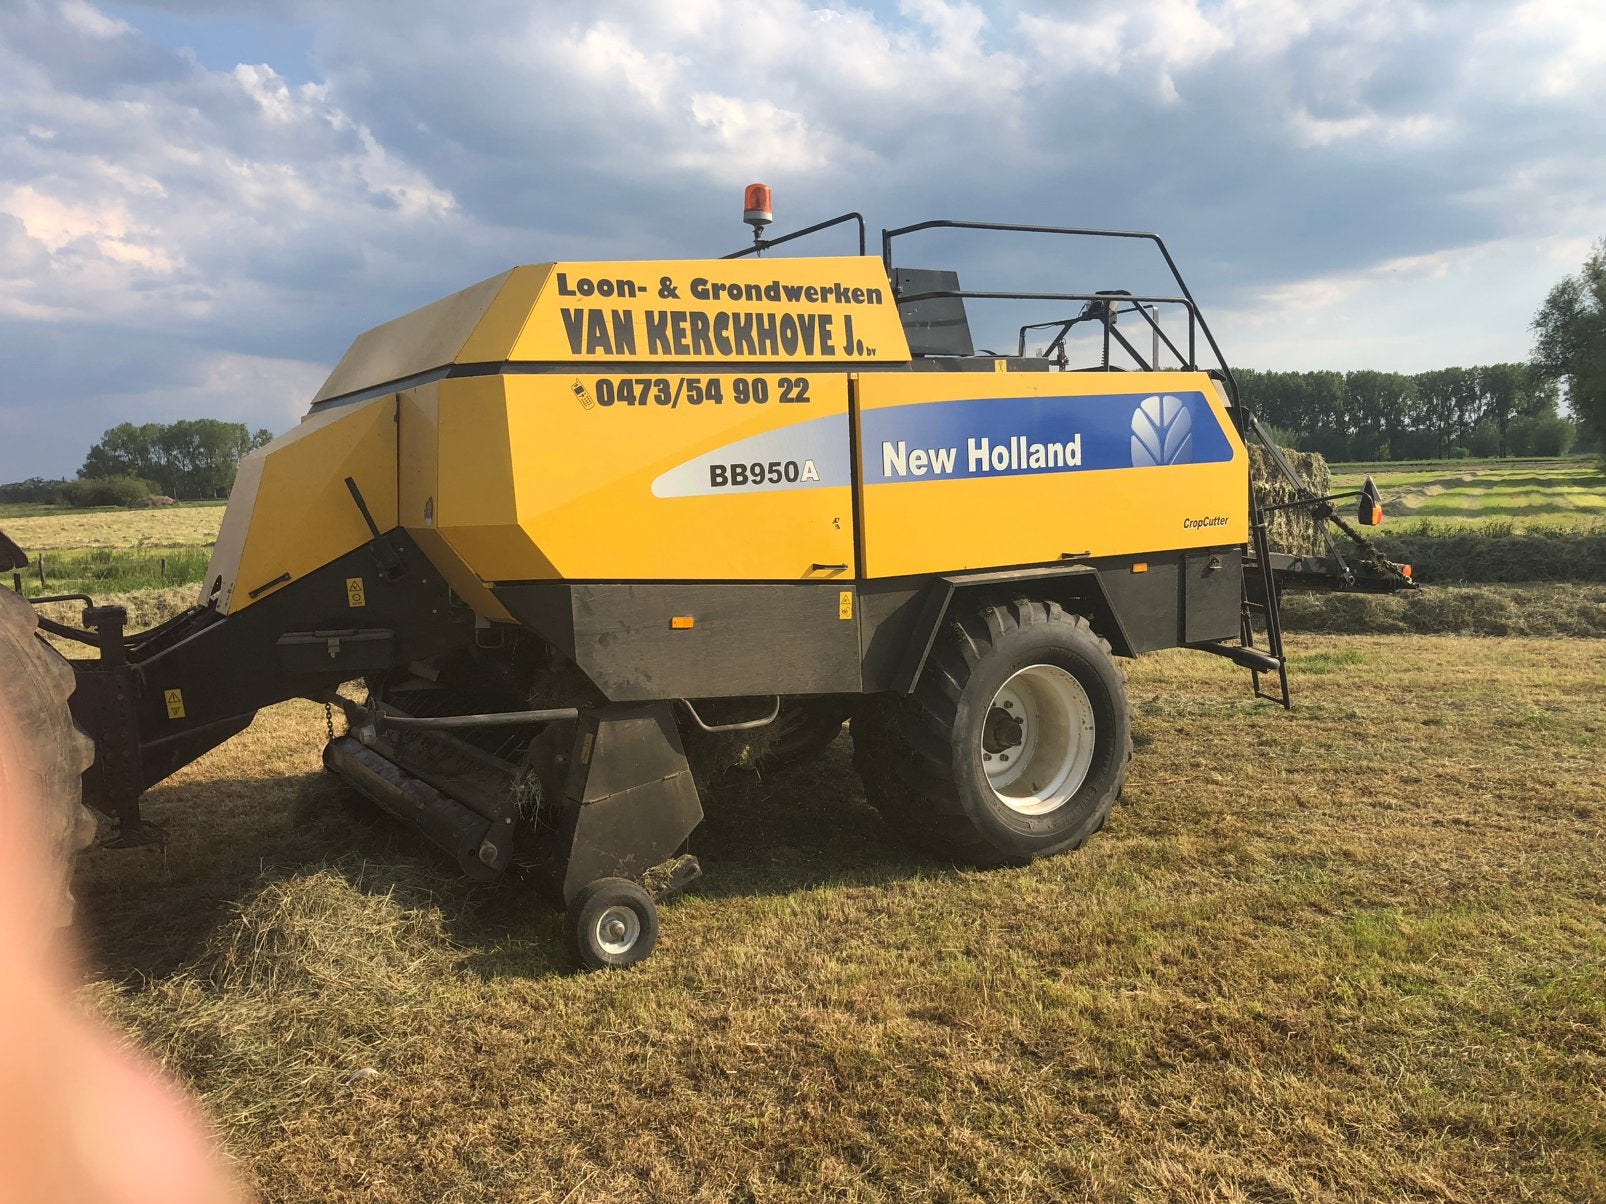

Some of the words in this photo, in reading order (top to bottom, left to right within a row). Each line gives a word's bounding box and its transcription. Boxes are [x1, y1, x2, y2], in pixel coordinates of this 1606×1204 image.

[556, 272, 647, 298] Loon-
[658, 276, 681, 300] &
[690, 277, 883, 305] Grondwerken
[560, 307, 637, 355] VAN
[644, 309, 835, 357] KERCKHOVE
[843, 314, 864, 357] J.
[865, 346, 877, 357] bv
[595, 377, 723, 409] 0473/54
[733, 377, 769, 404] 90
[777, 377, 811, 404] 22
[882, 441, 957, 477] New
[967, 433, 1082, 472] Holland
[709, 459, 820, 488] BB950A
[1183, 516, 1229, 530] CropCutter
